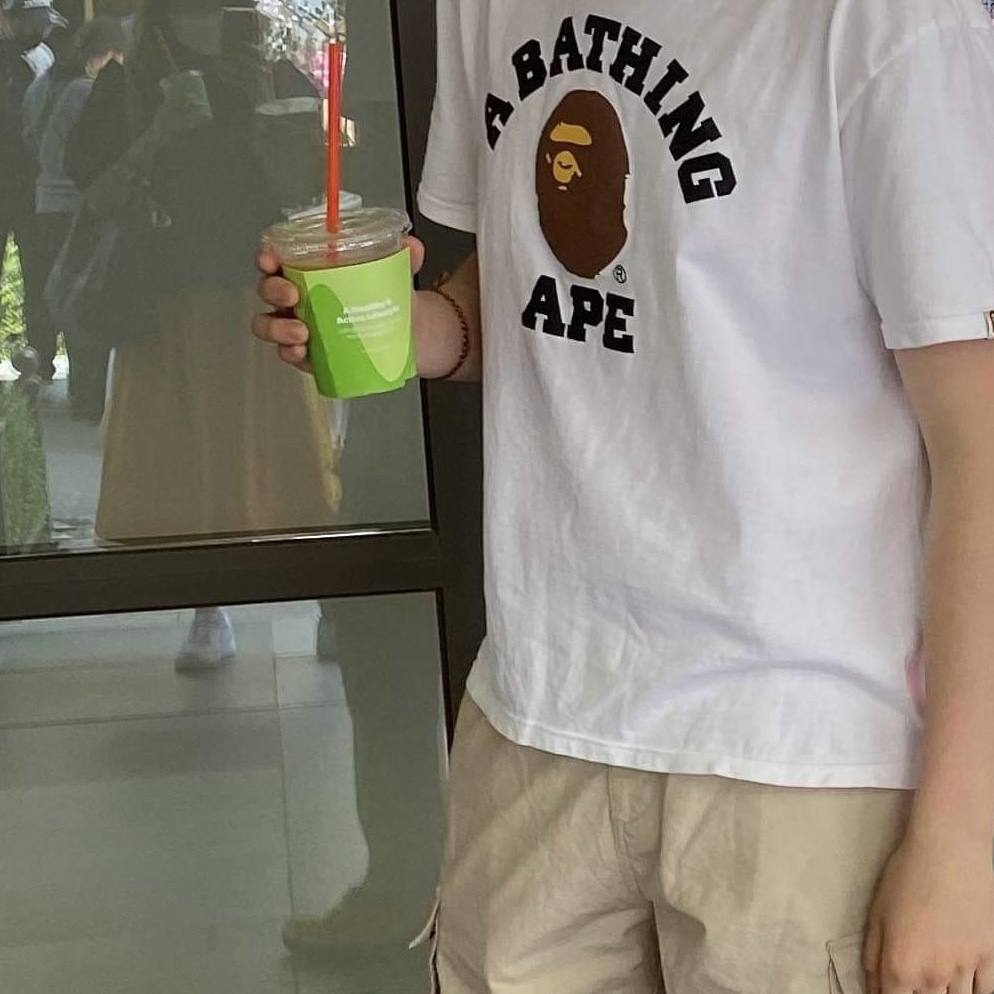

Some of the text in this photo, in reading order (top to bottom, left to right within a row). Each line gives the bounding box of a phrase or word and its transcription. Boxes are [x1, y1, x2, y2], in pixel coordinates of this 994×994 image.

[485, 14, 737, 204] A BATHING
[522, 274, 635, 354] APE
